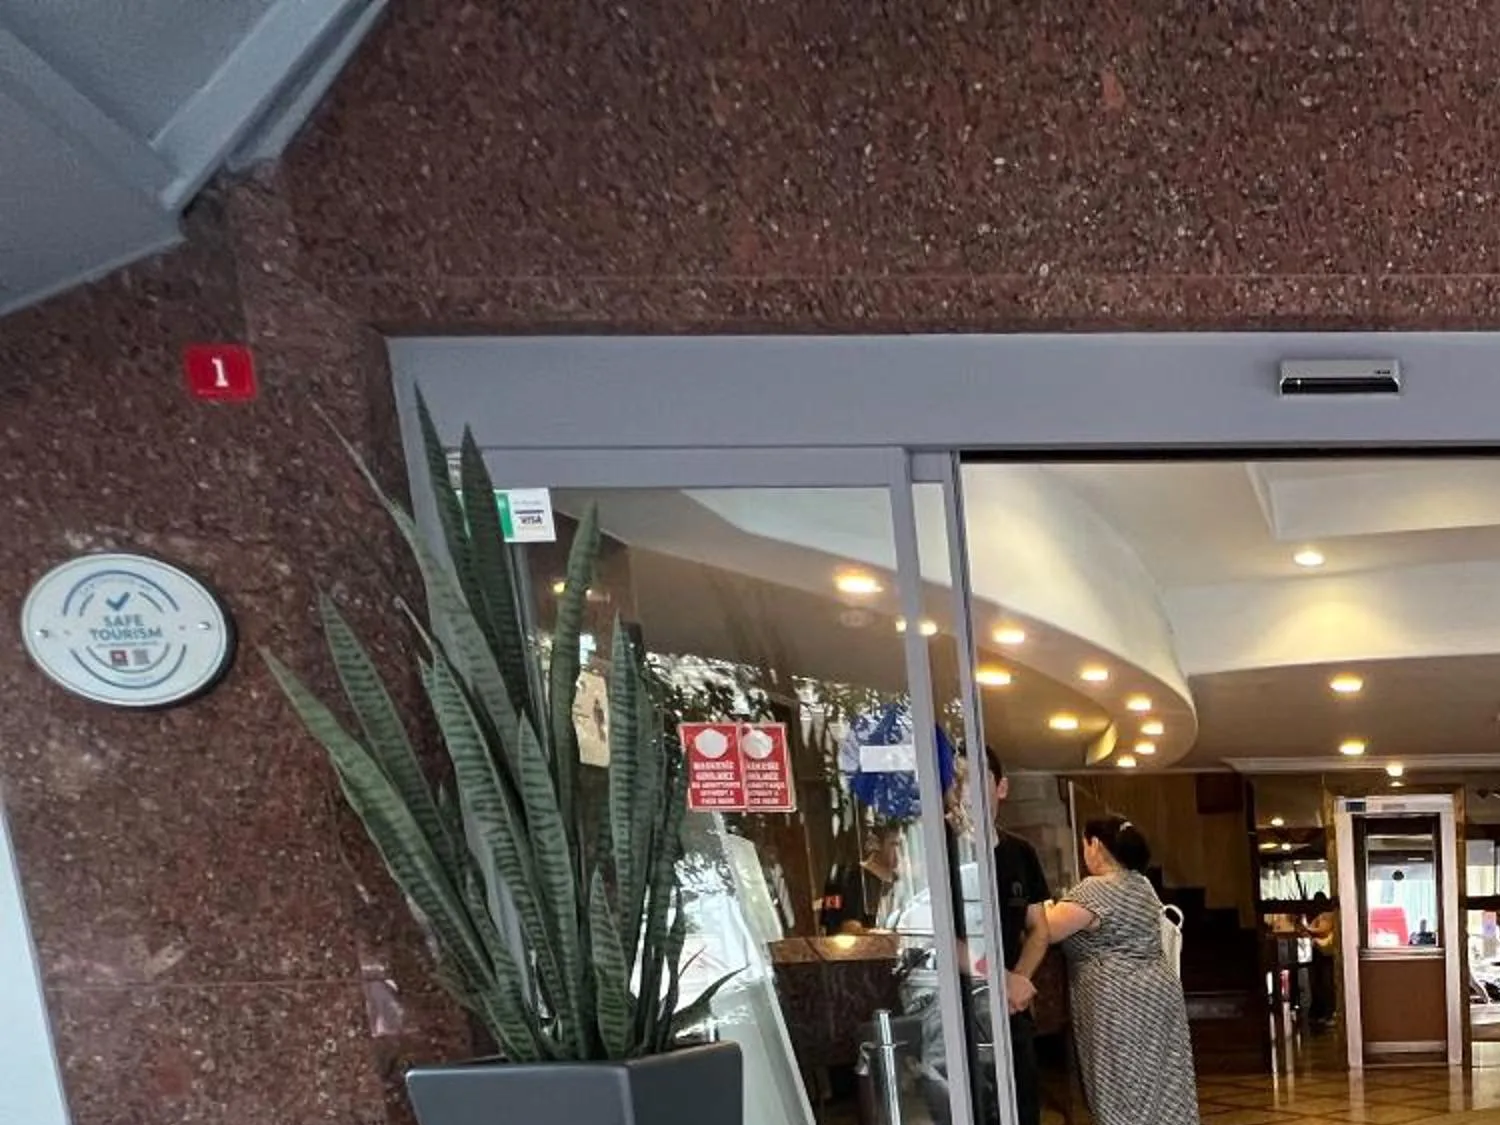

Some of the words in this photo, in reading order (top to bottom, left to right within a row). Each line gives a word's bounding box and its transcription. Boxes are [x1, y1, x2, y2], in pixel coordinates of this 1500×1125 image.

[211, 357, 229, 388] 1
[103, 613, 145, 628] SAFE
[89, 625, 163, 641] TOURISM
